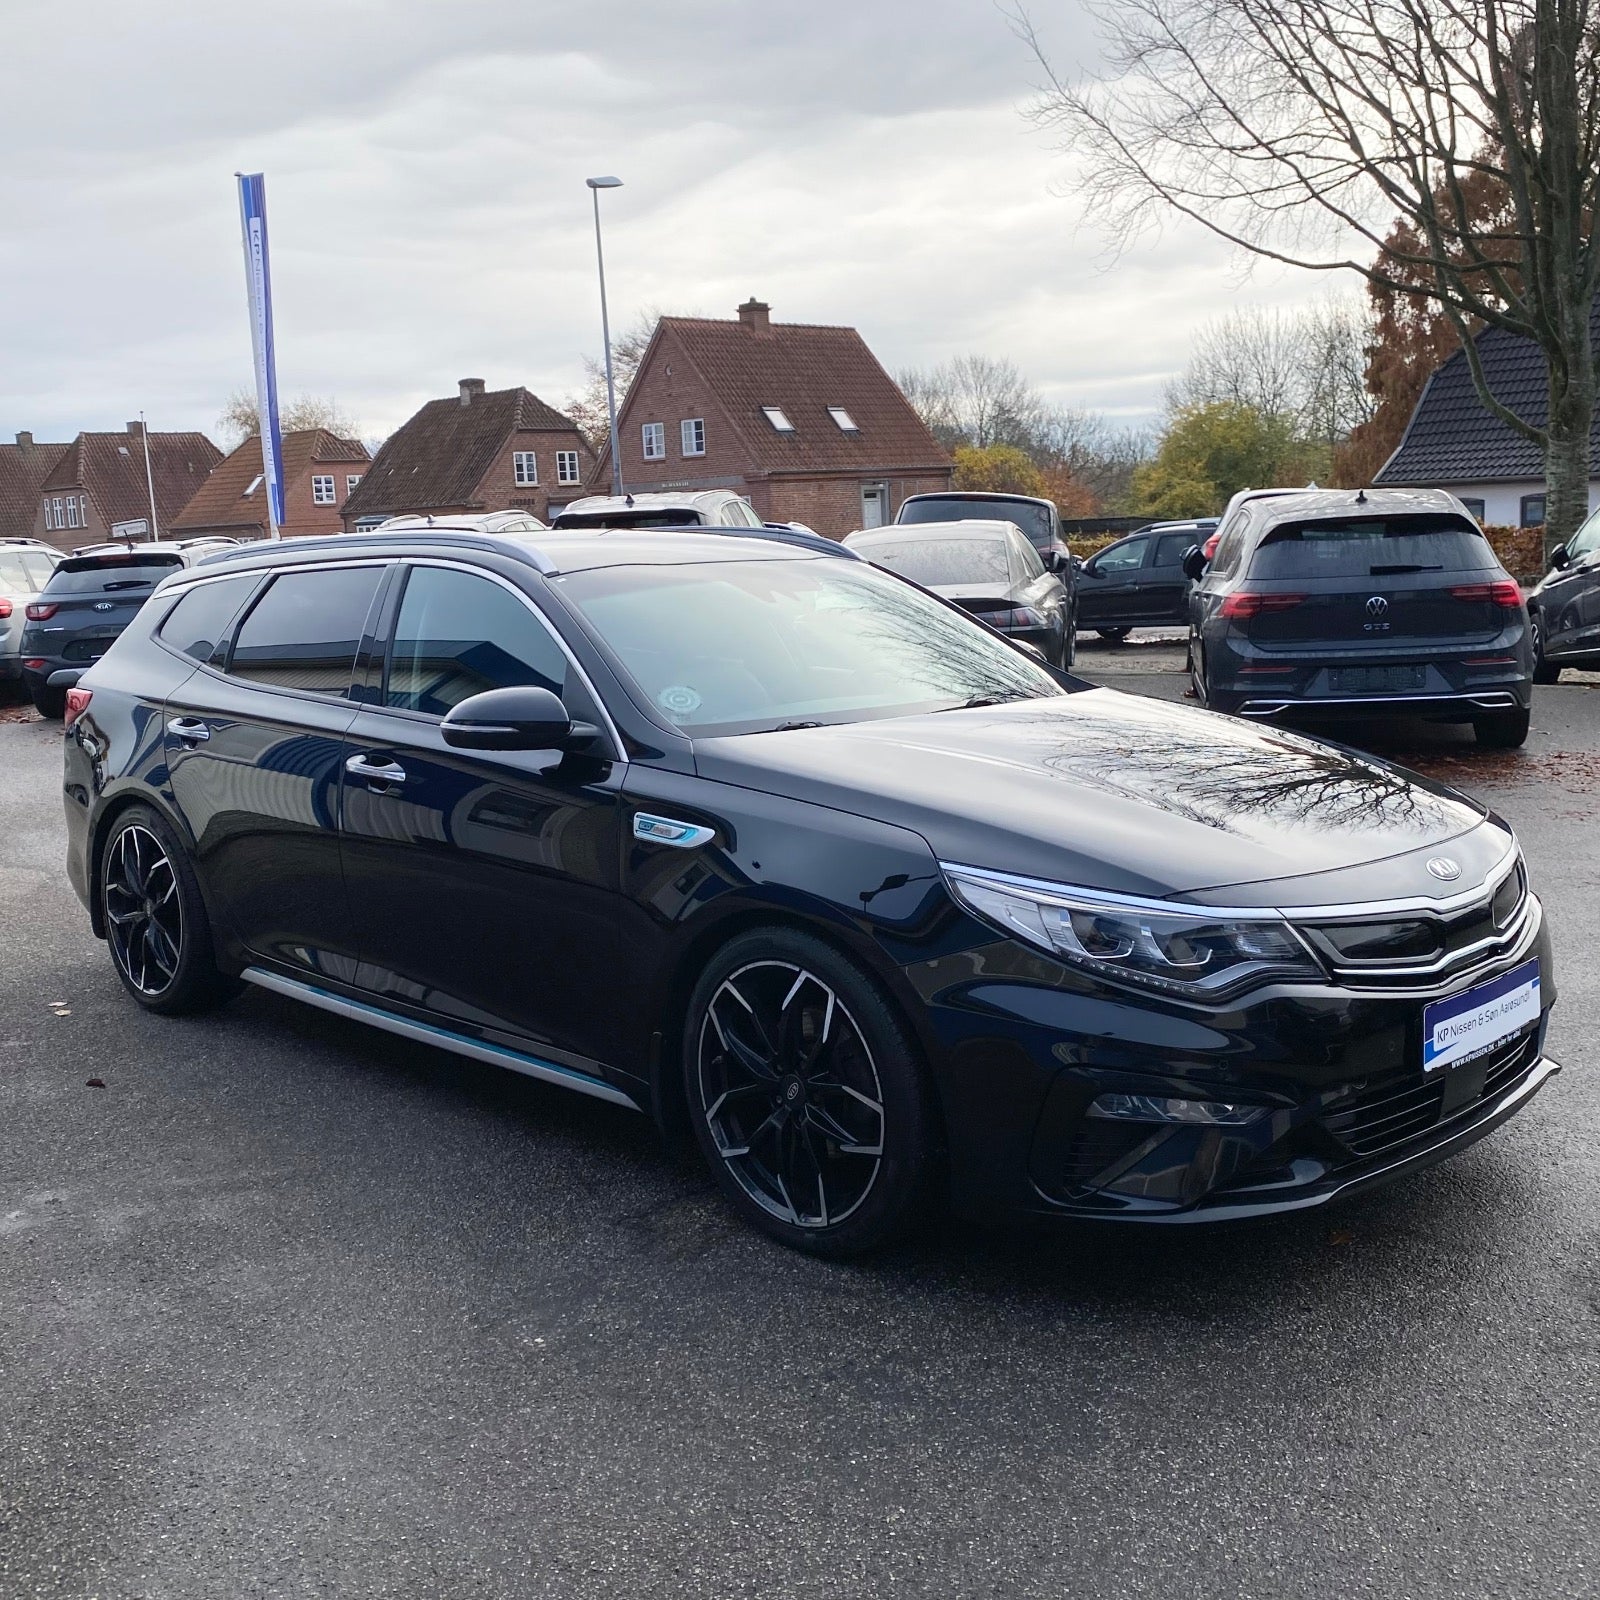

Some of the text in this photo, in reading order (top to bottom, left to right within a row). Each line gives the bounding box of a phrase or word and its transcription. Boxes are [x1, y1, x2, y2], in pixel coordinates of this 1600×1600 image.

[1437, 1027, 1449, 1044] KP
[1450, 1019, 1477, 1038] Nissen
[1478, 1013, 1484, 1026] &
